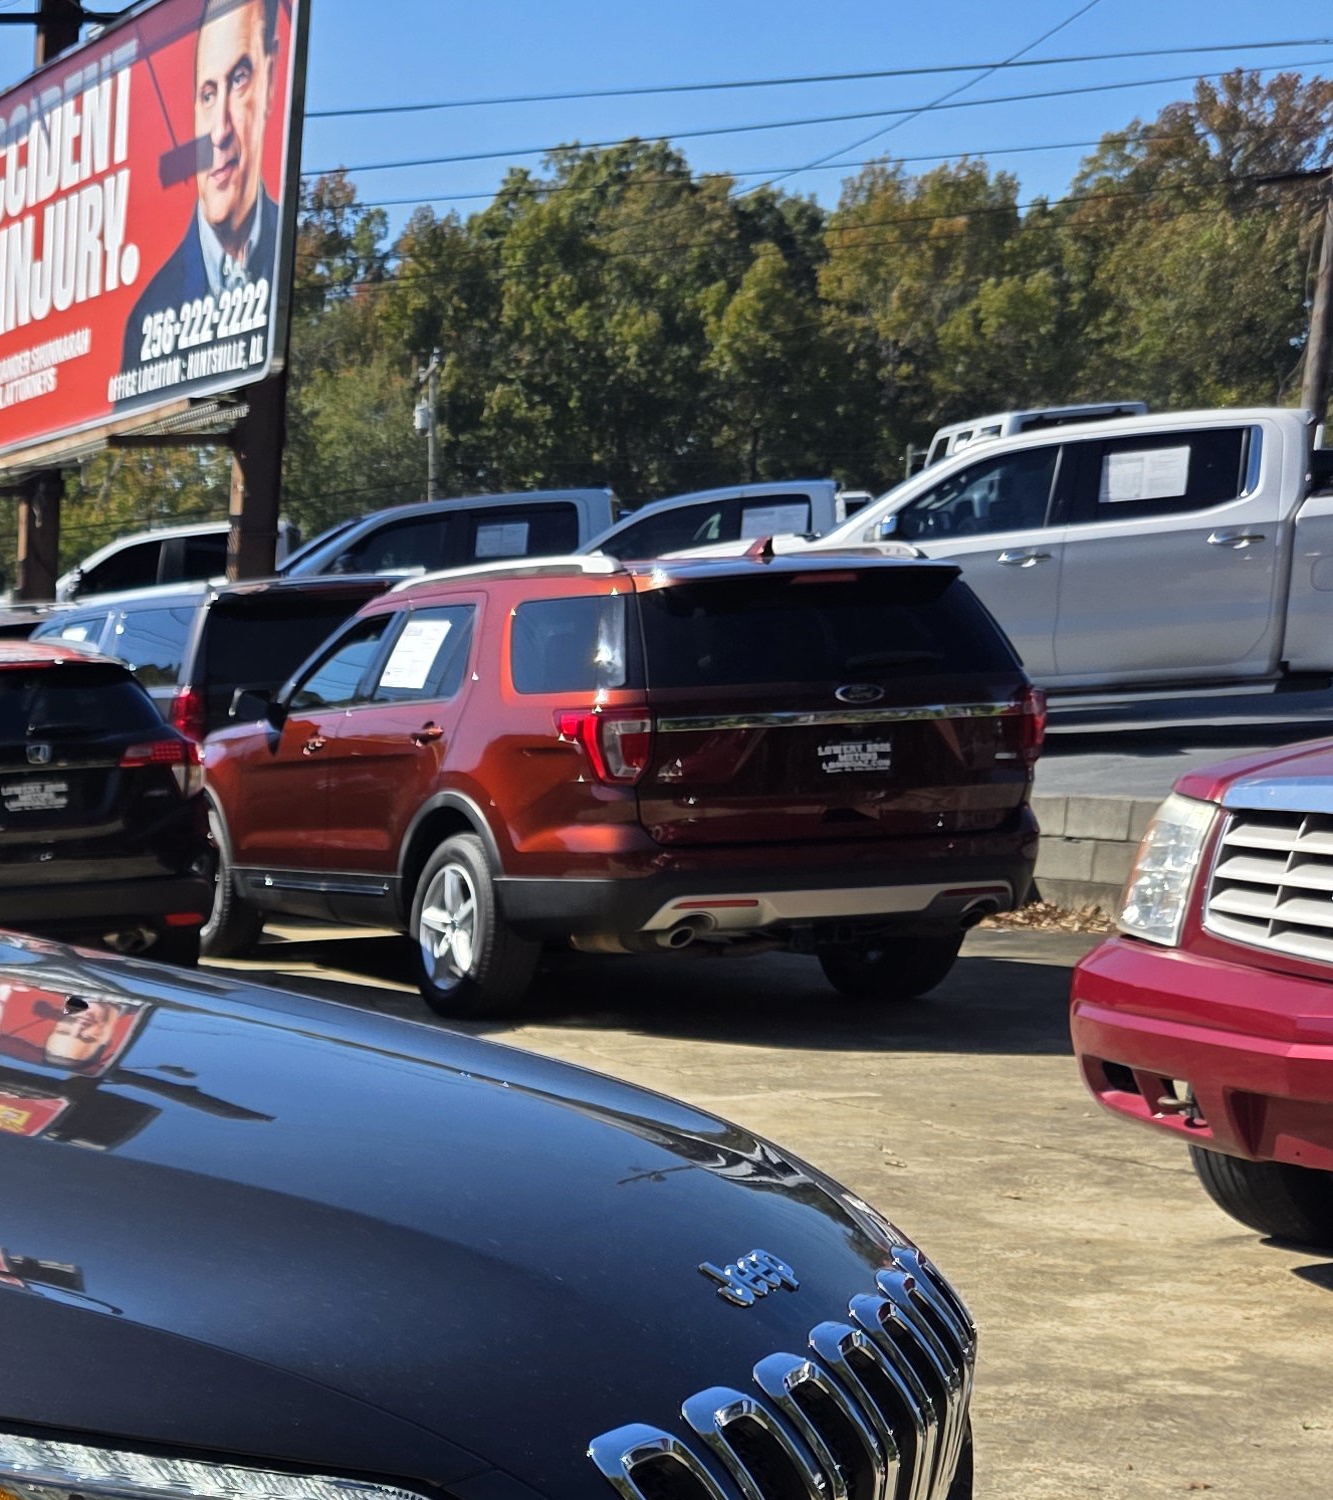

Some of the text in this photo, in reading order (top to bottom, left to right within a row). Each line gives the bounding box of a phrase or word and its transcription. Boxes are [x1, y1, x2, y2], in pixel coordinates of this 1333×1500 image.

[140, 277, 269, 361] 256-222-2222
[107, 368, 138, 403] OFFICE
[138, 355, 182, 393] LOCATION
[697, 1248, 800, 1308] Jeep
